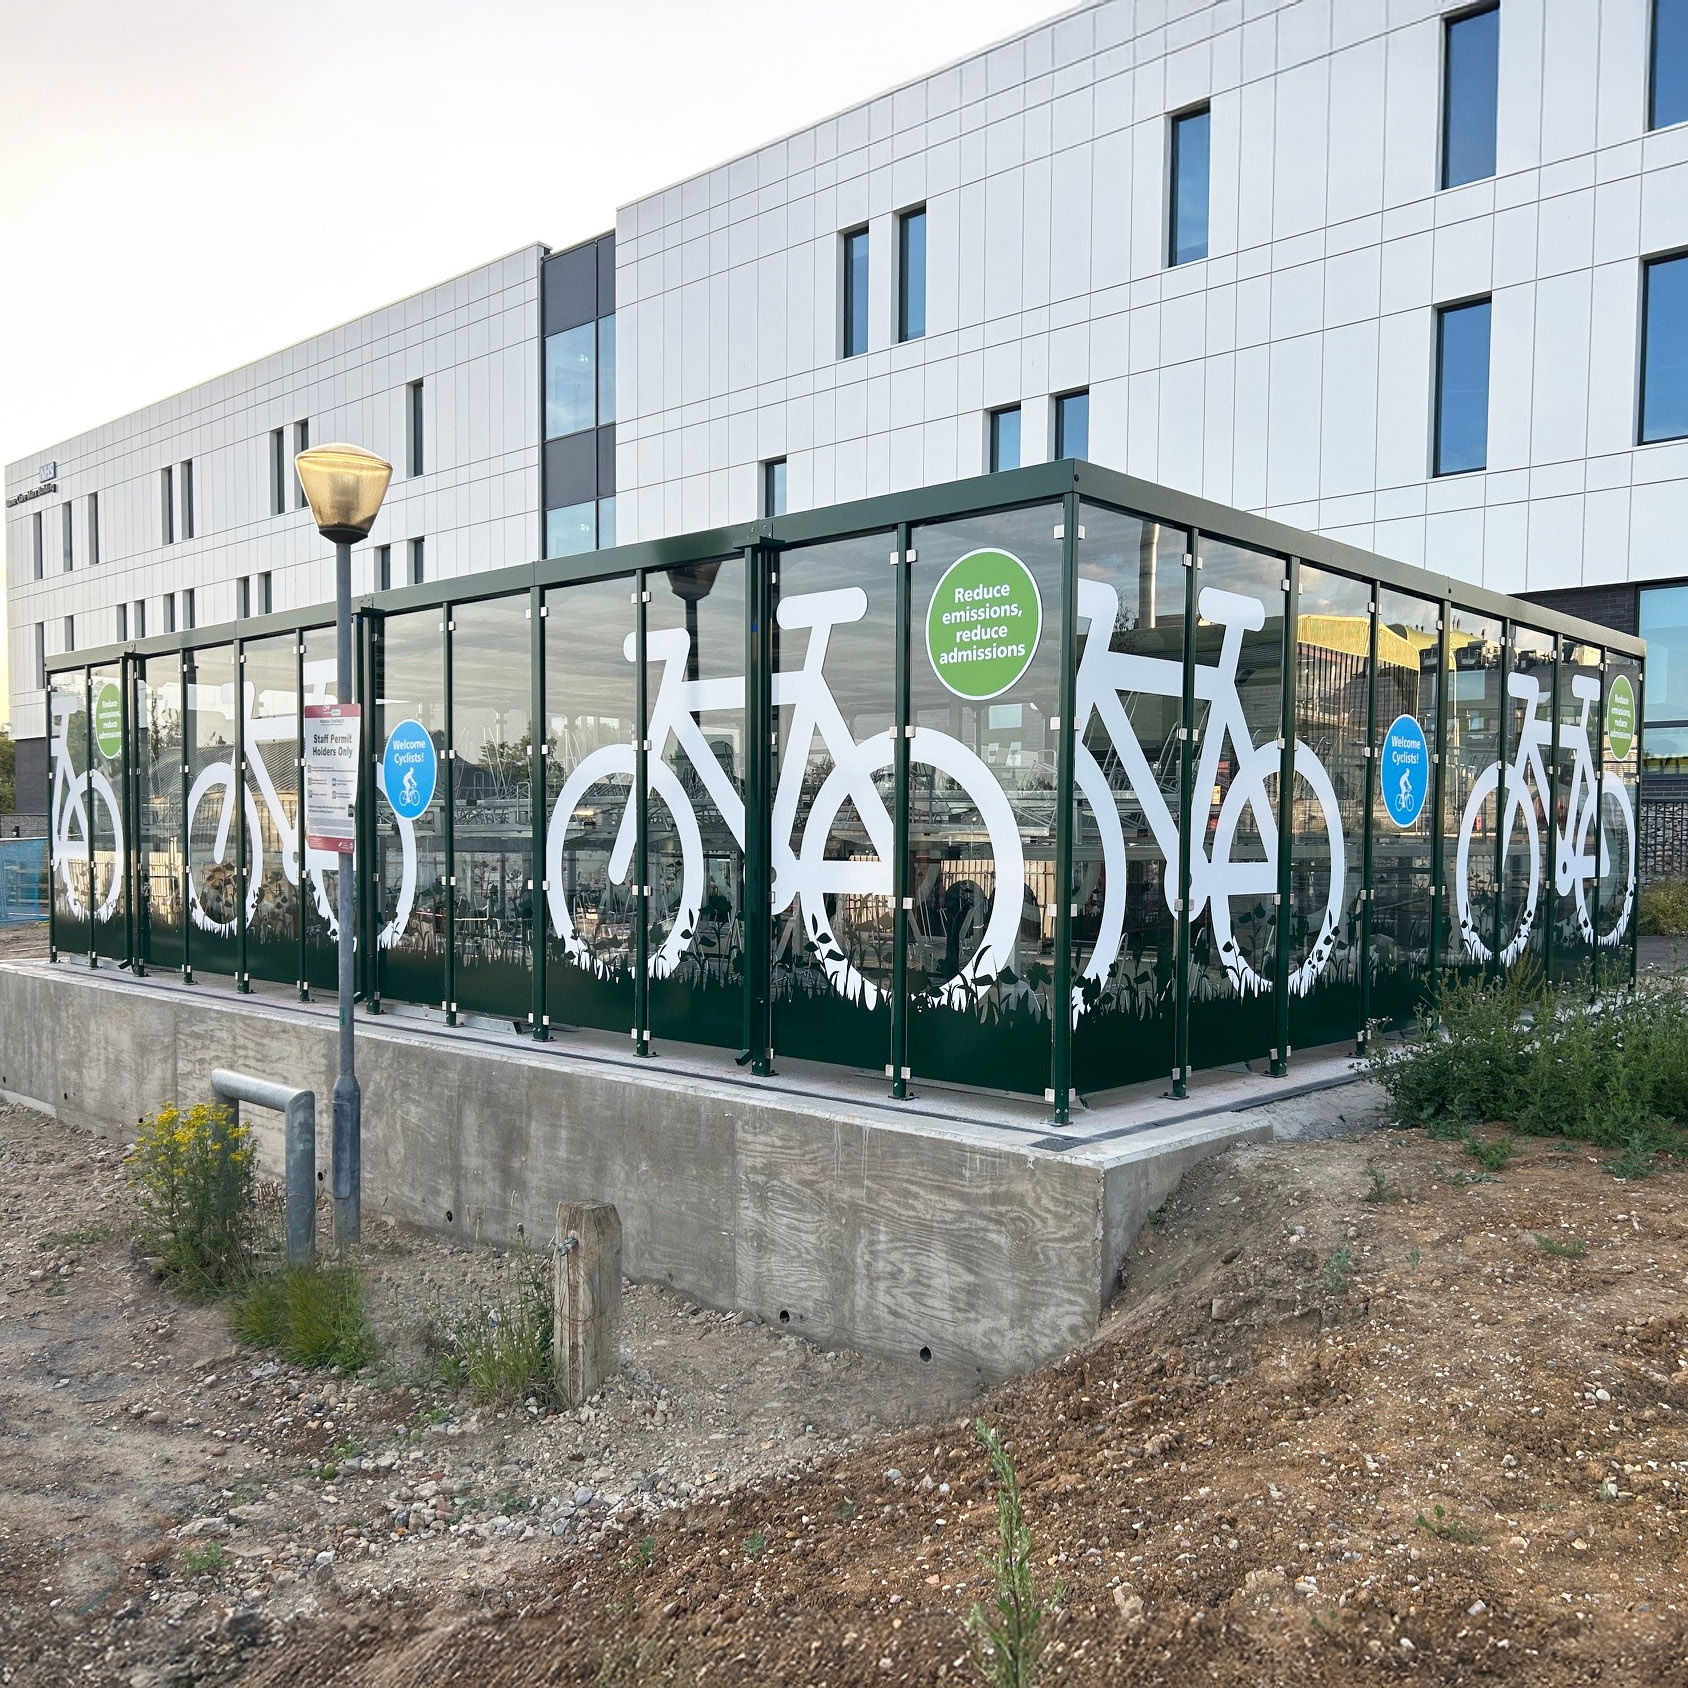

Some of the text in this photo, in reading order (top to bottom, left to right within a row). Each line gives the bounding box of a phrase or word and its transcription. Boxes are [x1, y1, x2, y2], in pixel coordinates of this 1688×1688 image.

[954, 583, 1010, 603] Reduce
[942, 602, 1022, 625] emissions,
[956, 624, 1008, 643] reduce
[939, 642, 1025, 665] admissions
[313, 734, 352, 744] Staff Permit
[392, 738, 426, 750] Welcome
[1391, 735, 1421, 750] Welcome
[312, 746, 353, 759] Holders Only
[393, 752, 424, 766] Cyclists!
[1392, 750, 1419, 766] Cyclists!
